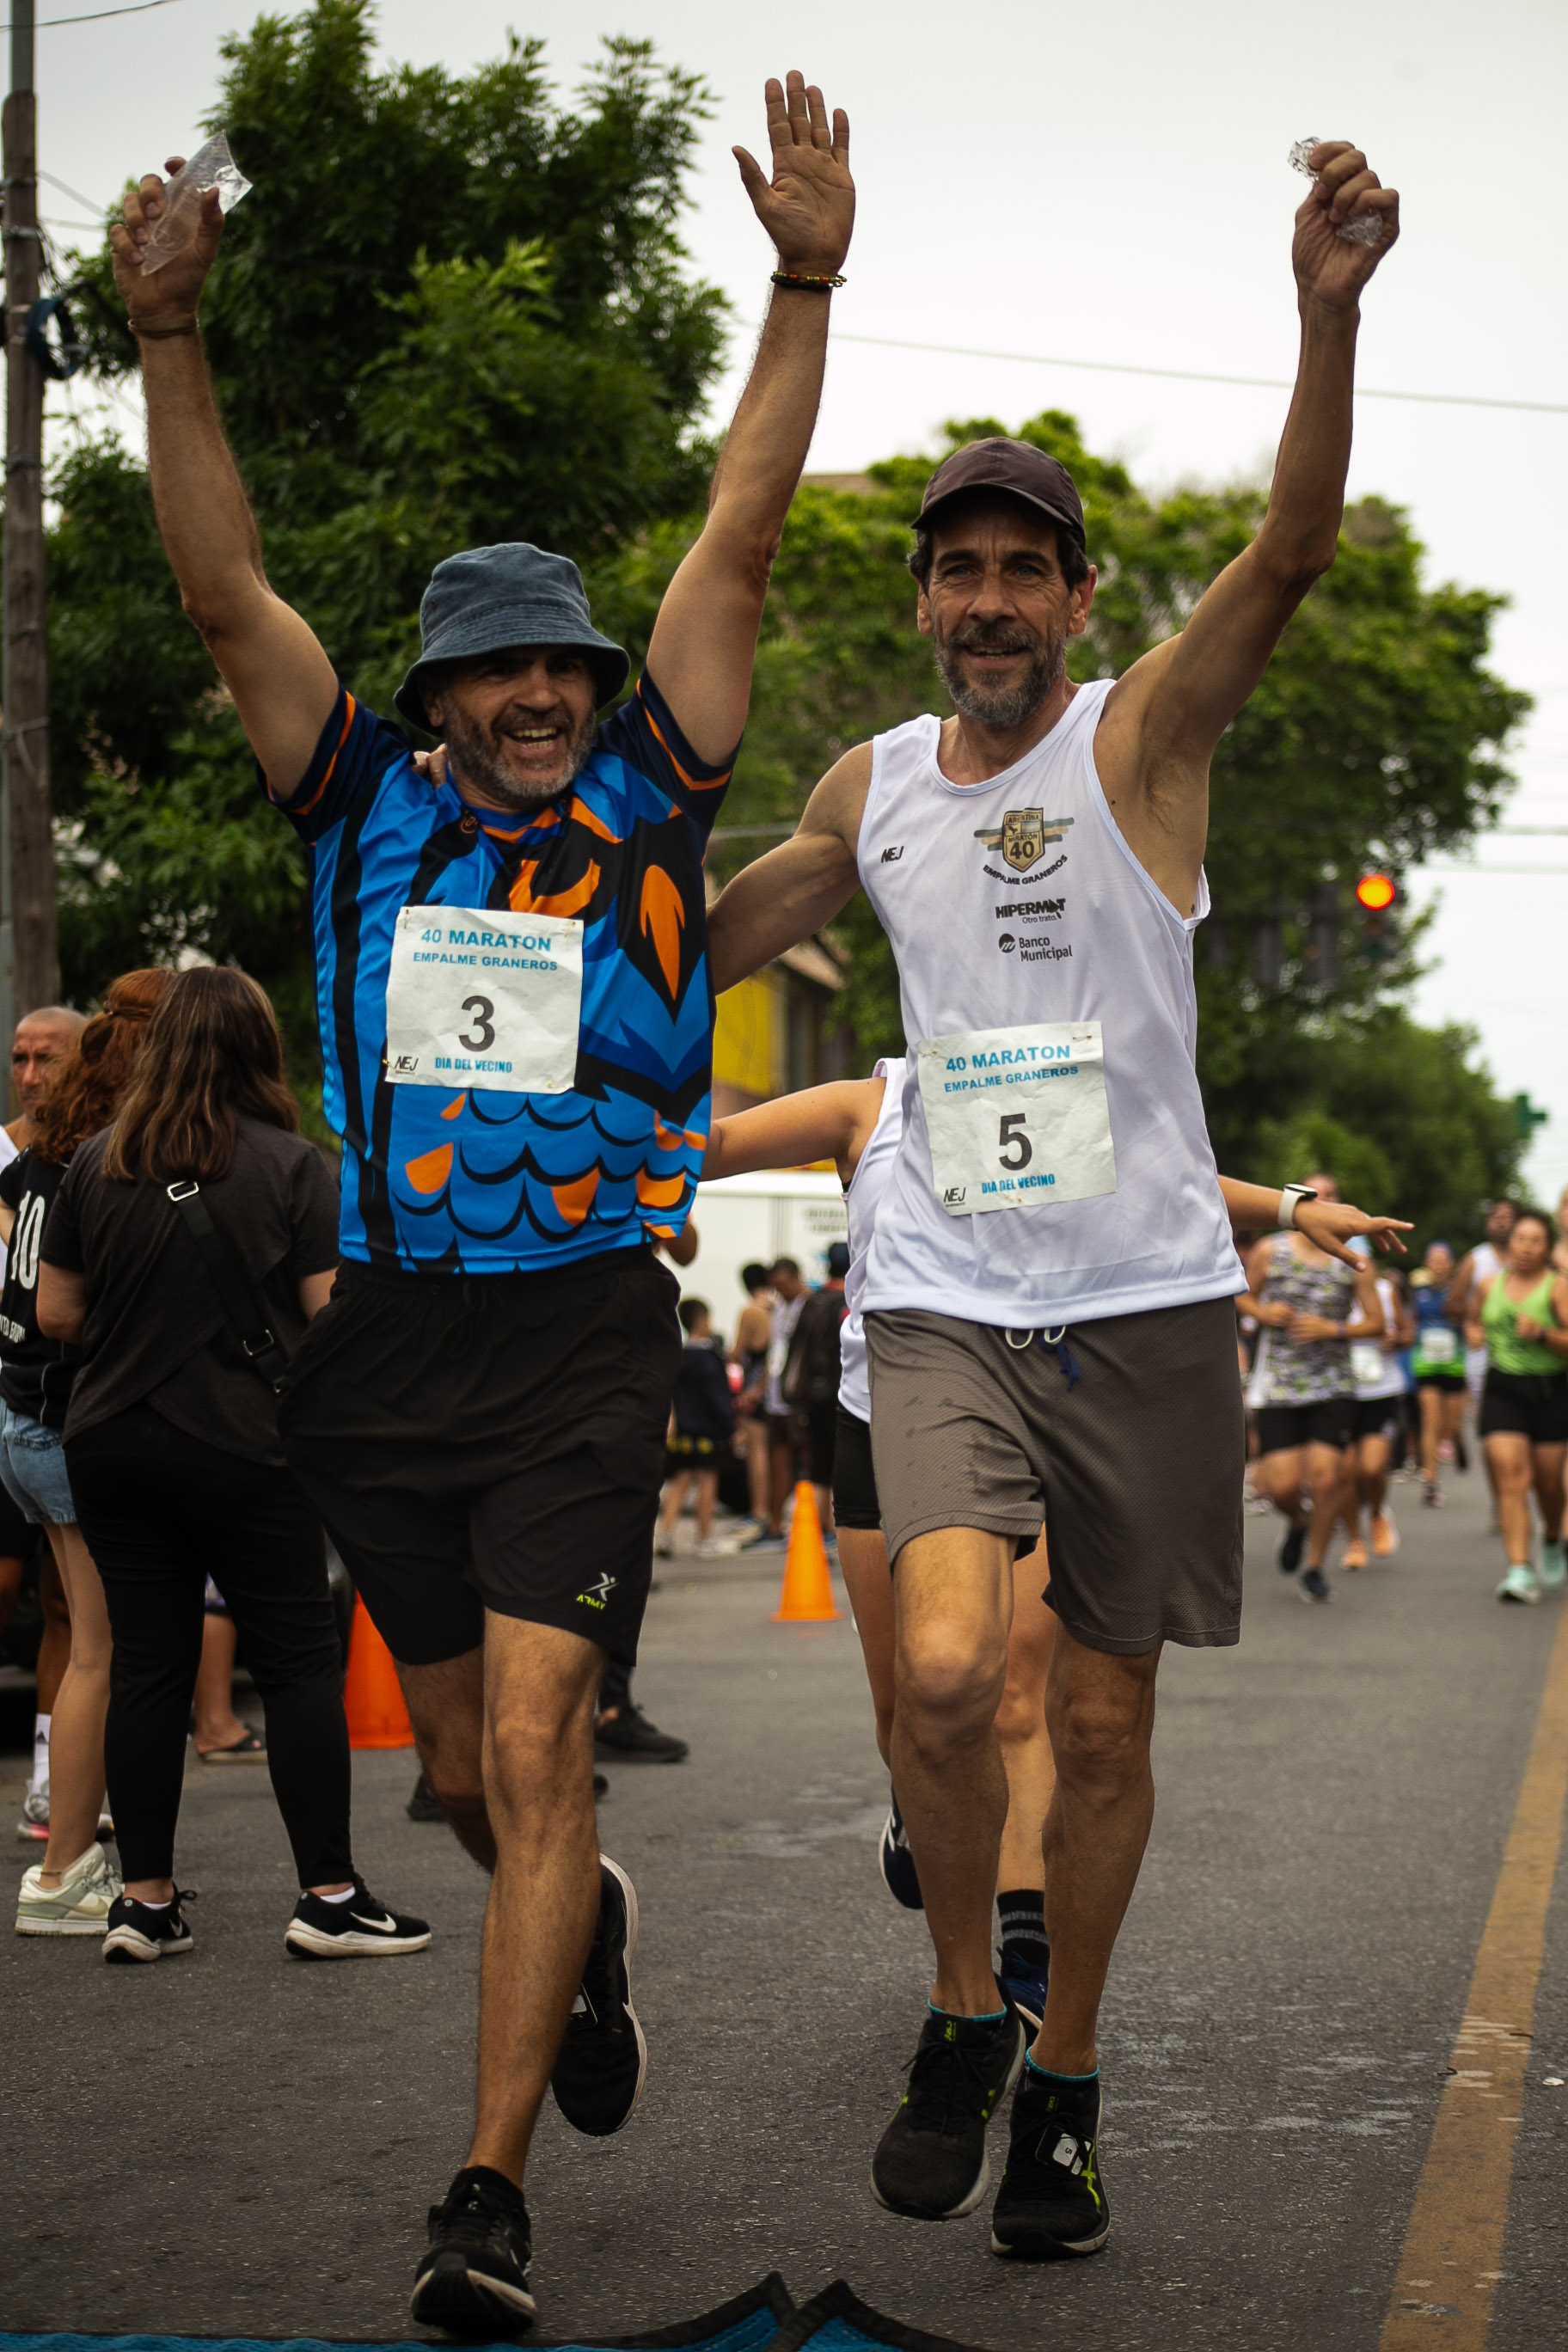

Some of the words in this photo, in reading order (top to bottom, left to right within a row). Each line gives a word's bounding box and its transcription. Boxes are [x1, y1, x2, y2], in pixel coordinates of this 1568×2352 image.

[1009, 840, 1035, 860] 40
[983, 865, 1021, 885] EMPALME
[1021, 854, 1069, 885] GRANEROS
[1021, 916, 1038, 925] Otro
[421, 929, 442, 944] 40
[448, 930, 552, 952] MARATON
[1019, 935, 1050, 949] Banco
[413, 952, 477, 965] EMPALME
[481, 956, 558, 971] GRANEROS
[1020, 944, 1073, 963] Municipal
[458, 995, 496, 1053] 3
[434, 1057, 450, 1070] DIA
[454, 1057, 474, 1071] DEL
[475, 1060, 513, 1074] VECINO
[946, 1057, 967, 1073] 40
[972, 1045, 1071, 1069] MARATON
[944, 1075, 1003, 1093] EMPALME
[1005, 1065, 1079, 1085] GRANEROS
[998, 1112, 1033, 1172] 5
[981, 1180, 997, 1194] DIA
[999, 1179, 1017, 1192] DEL
[1018, 1173, 1056, 1190] VECINO
[10, 1190, 46, 1289] 10
